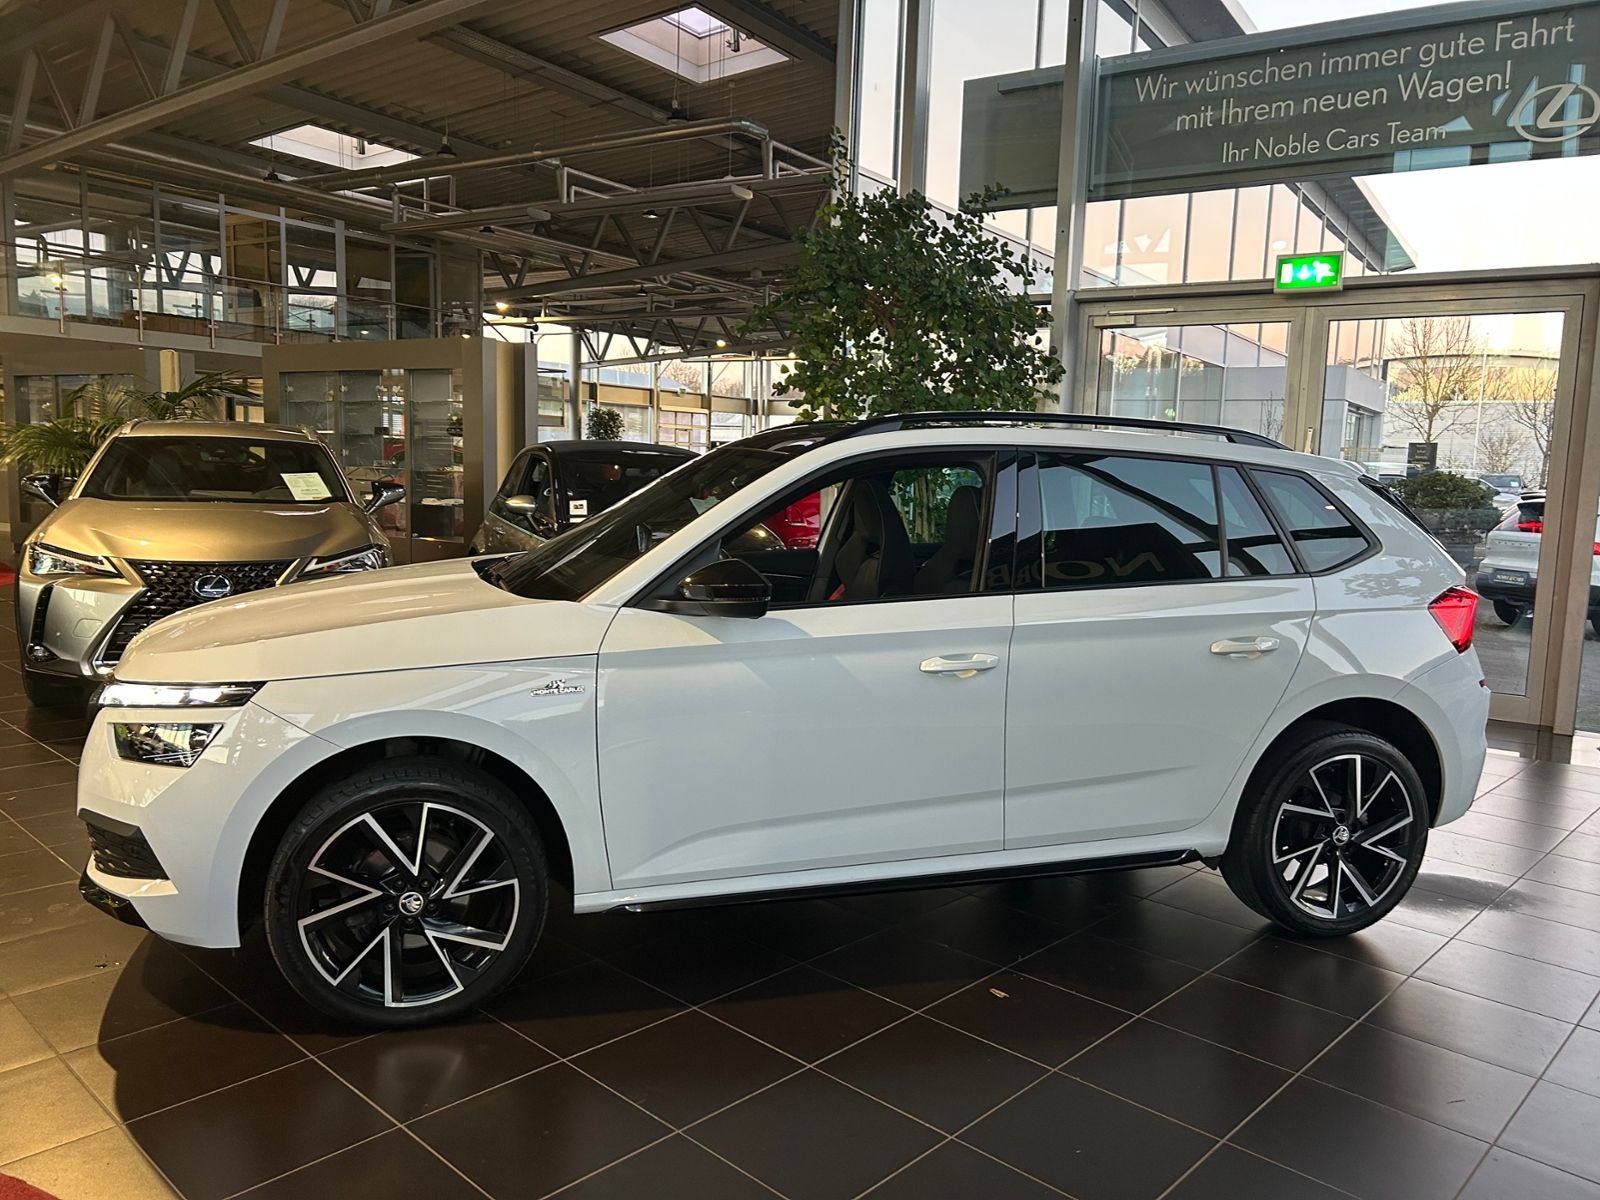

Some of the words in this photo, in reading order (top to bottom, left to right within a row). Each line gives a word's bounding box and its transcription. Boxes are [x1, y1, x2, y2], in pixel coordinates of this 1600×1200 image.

[1135, 73, 1178, 101] Wir
[1184, 56, 1312, 95] wünschen
[1320, 45, 1411, 75] immer
[1419, 33, 1484, 68] gute
[1495, 17, 1575, 51] Fahrt
[1176, 105, 1213, 131] mit
[1221, 98, 1294, 125] Ihrem
[1303, 87, 1387, 114] neuen
[1398, 60, 1512, 102] Wagen!
[1222, 141, 1249, 163] Ihr
[1254, 132, 1320, 160] Noble
[1325, 128, 1379, 151] Cars
[1387, 121, 1447, 146] Team
